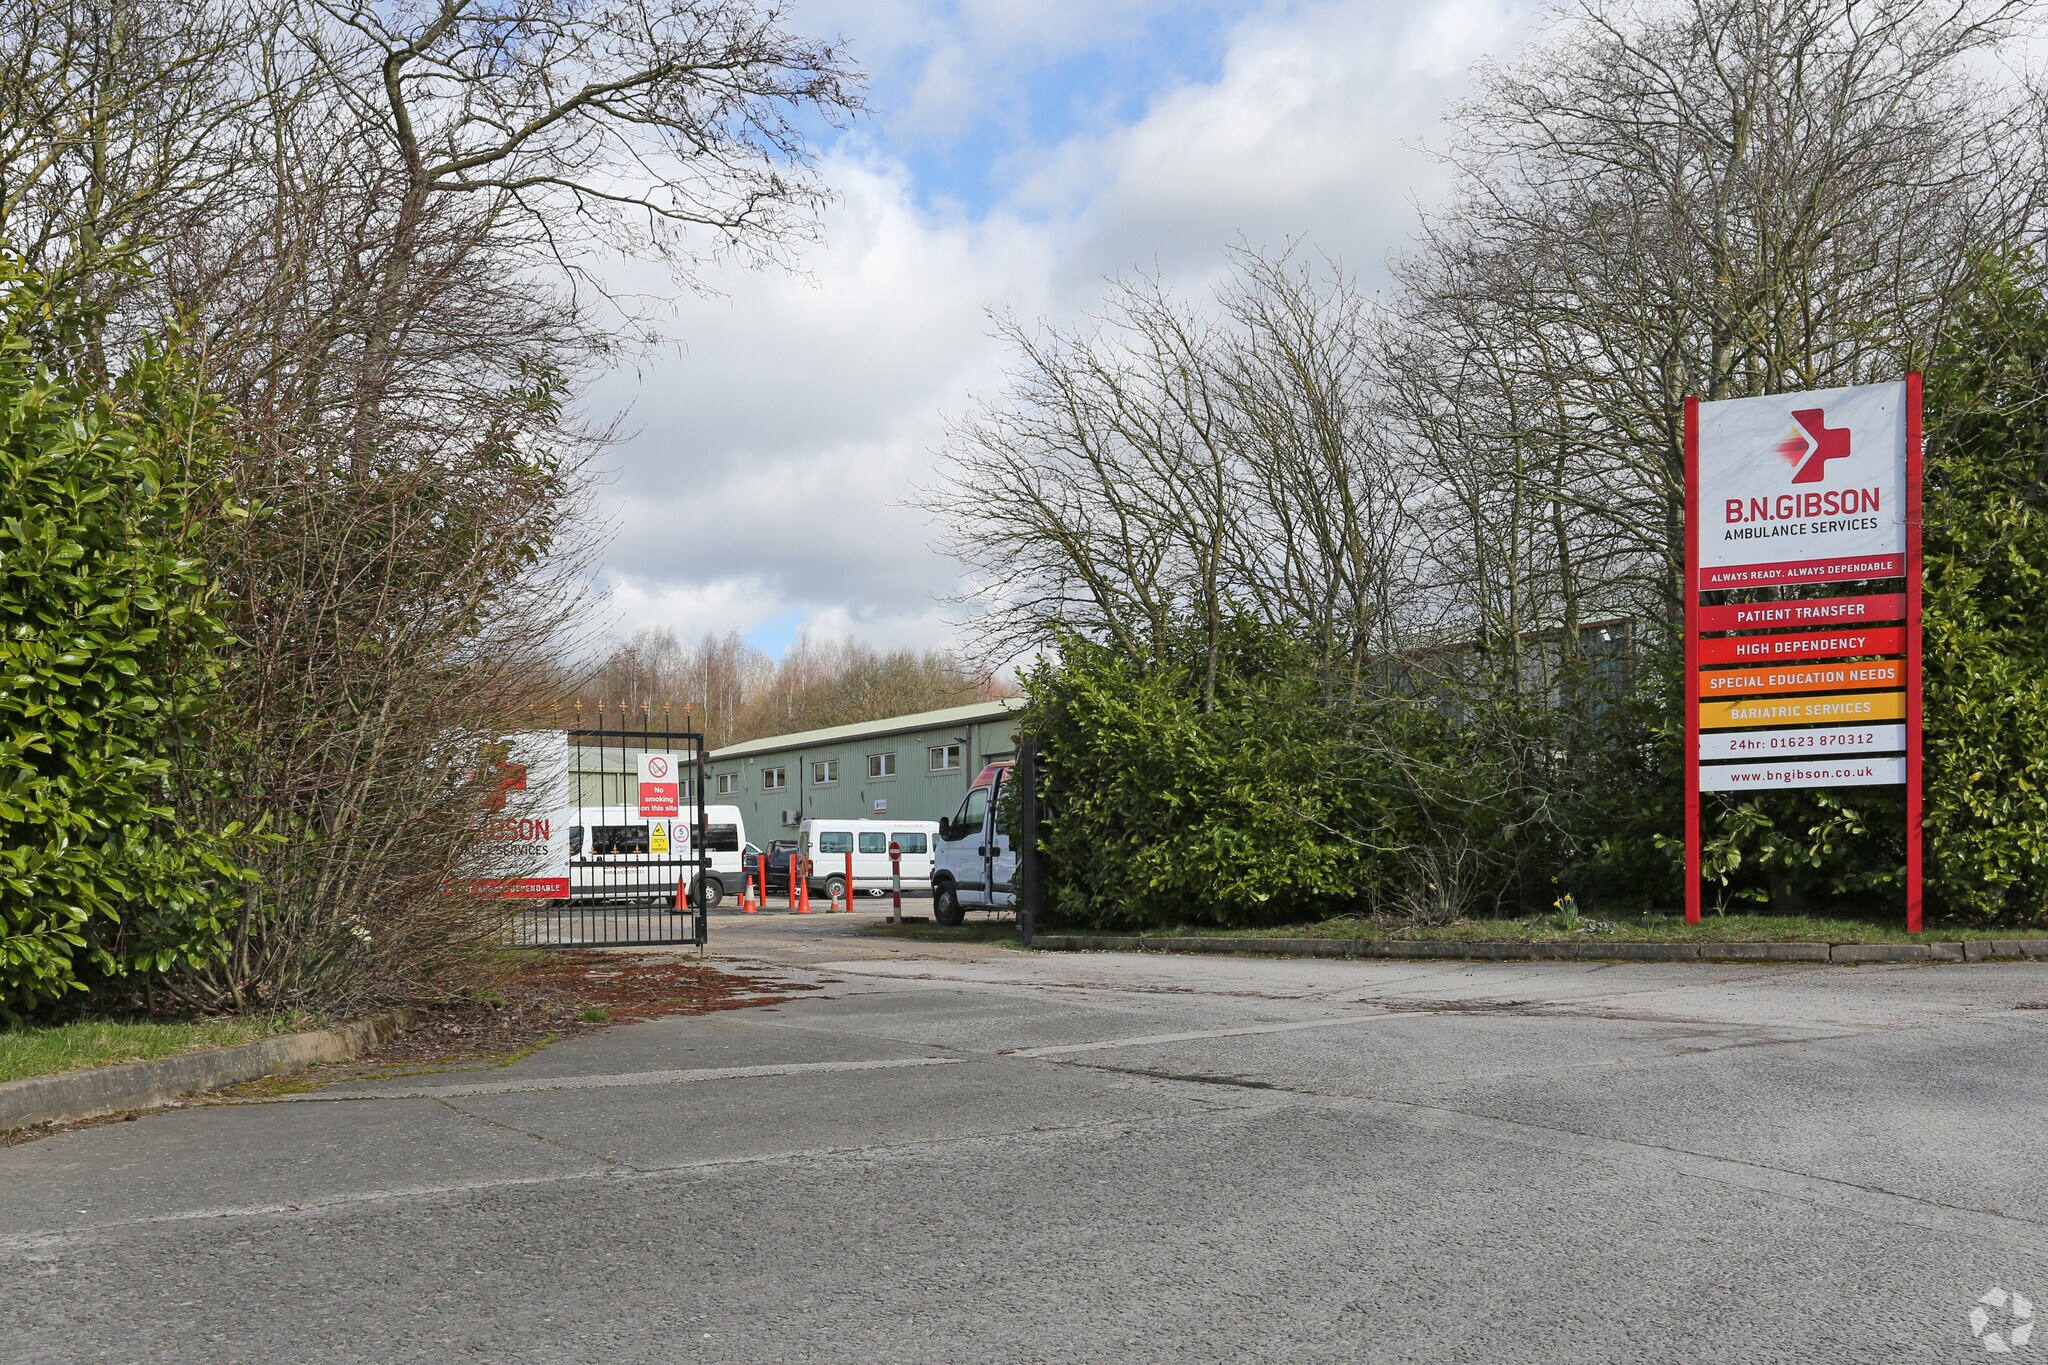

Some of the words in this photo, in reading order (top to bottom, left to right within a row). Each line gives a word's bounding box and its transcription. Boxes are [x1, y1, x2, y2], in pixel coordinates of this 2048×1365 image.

[1726, 487, 1880, 524] B.N.GIBSON
[1724, 524, 1807, 540] AMBULANCE
[1811, 517, 1878, 534] SERVICES
[1711, 572, 1748, 582] ALWAYS
[1750, 569, 1785, 580] READY.
[1787, 566, 1825, 577] ALWAYS
[1828, 561, 1893, 574] DEPENDABLE
[1737, 608, 1791, 622] PATIENT
[1796, 603, 1865, 618] TRANSFER
[1736, 642, 1770, 656] HIGH
[1774, 637, 1866, 653] DEPENDENCY
[1710, 674, 1764, 689] SPECIAL
[1769, 671, 1845, 686] EDUCATION
[1849, 668, 1896, 682] NEEDS
[1731, 705, 1801, 720] BARIATRIC
[1805, 701, 1872, 716] SERVICES
[1730, 738, 1766, 750] 24hr:
[1770, 736, 1815, 748] 01623
[1819, 733, 1874, 746] 870312
[1730, 766, 1873, 782] www.bngibson.co.uk
